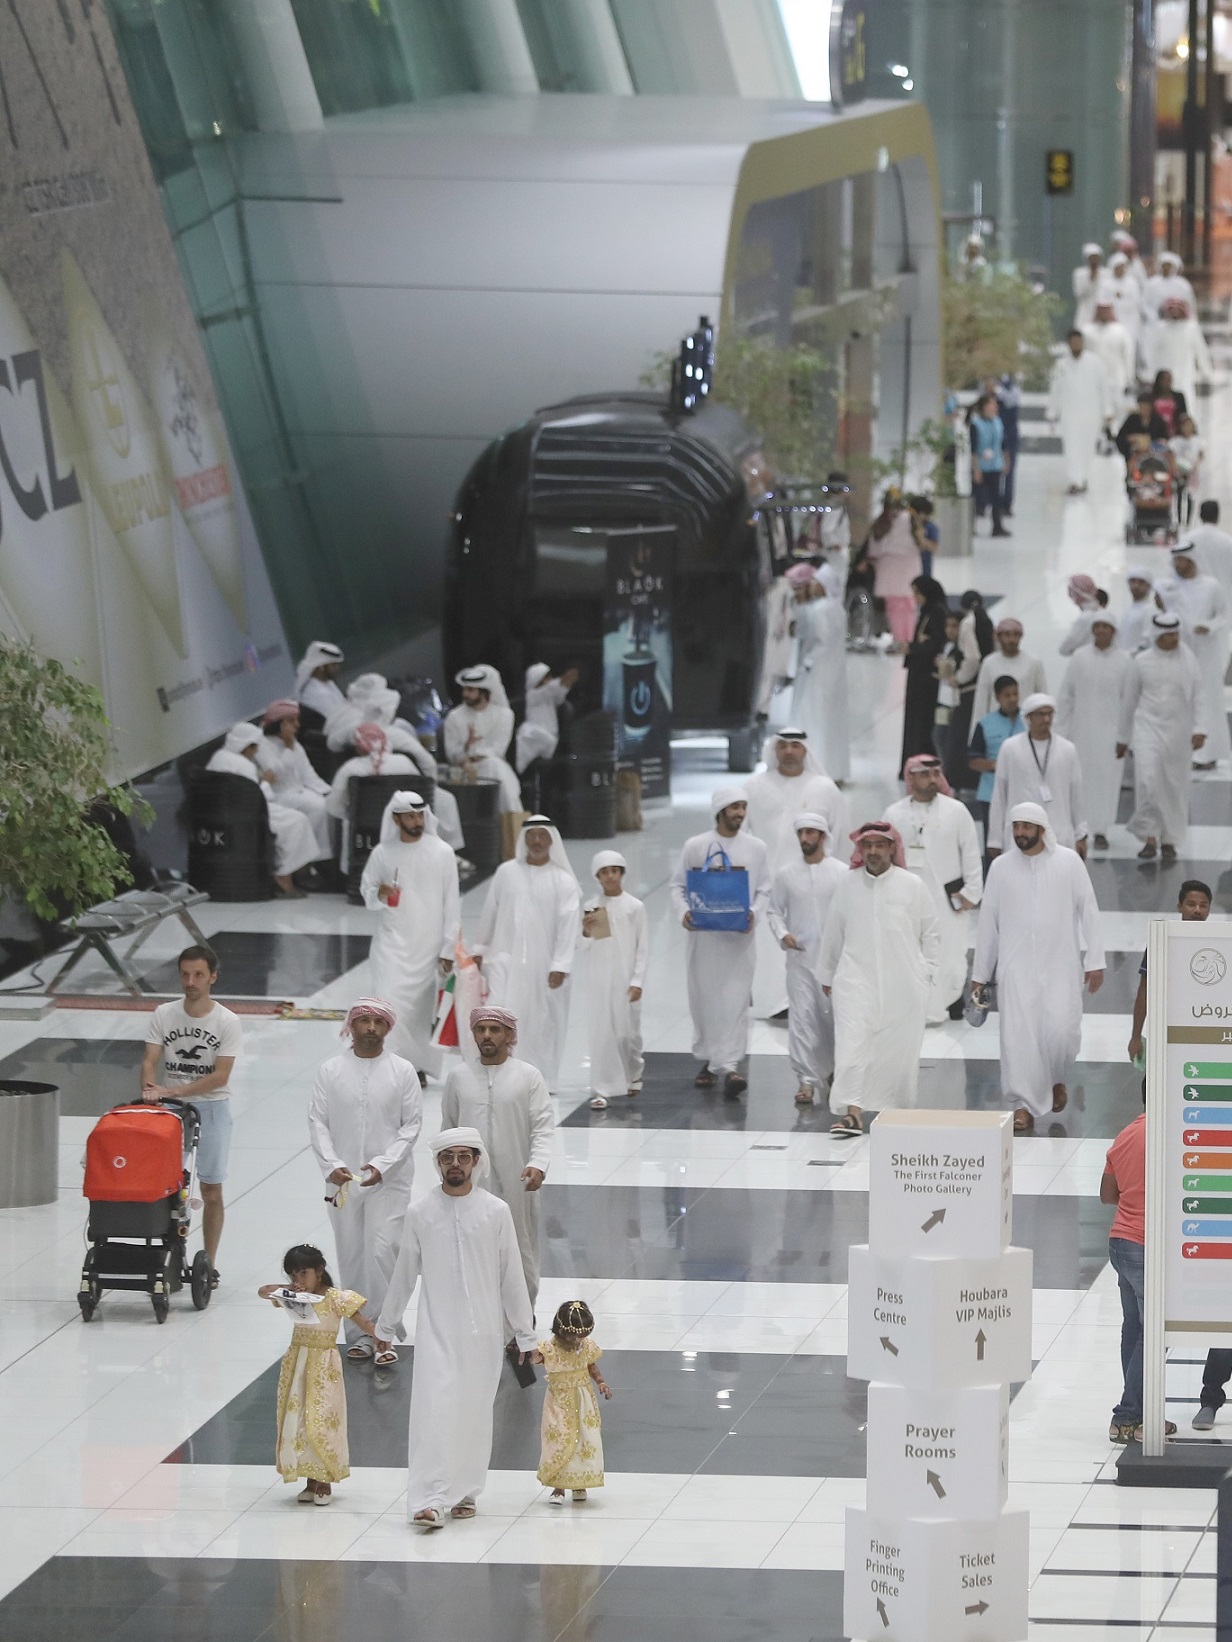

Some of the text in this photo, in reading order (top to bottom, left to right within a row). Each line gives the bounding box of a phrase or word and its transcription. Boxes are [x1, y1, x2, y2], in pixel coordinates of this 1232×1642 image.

[163, 1026, 221, 1051] HOLLISTER
[891, 1153, 985, 1171] Sheikh Zayed
[894, 1170, 982, 1181] The First Falconer
[903, 1183, 972, 1196] Photo Gallery
[877, 1288, 904, 1305] Press
[960, 1287, 1008, 1303] Houbara
[873, 1307, 907, 1326] Centre
[956, 1305, 1012, 1323] VIP Majlis
[906, 1424, 956, 1442] Prayer
[904, 1444, 956, 1459] Rooms
[870, 1539, 901, 1560] Finger
[960, 1553, 996, 1569] Ticket
[866, 1558, 905, 1583] Printing
[871, 1579, 899, 1598] Office
[961, 1573, 993, 1589] Sales
